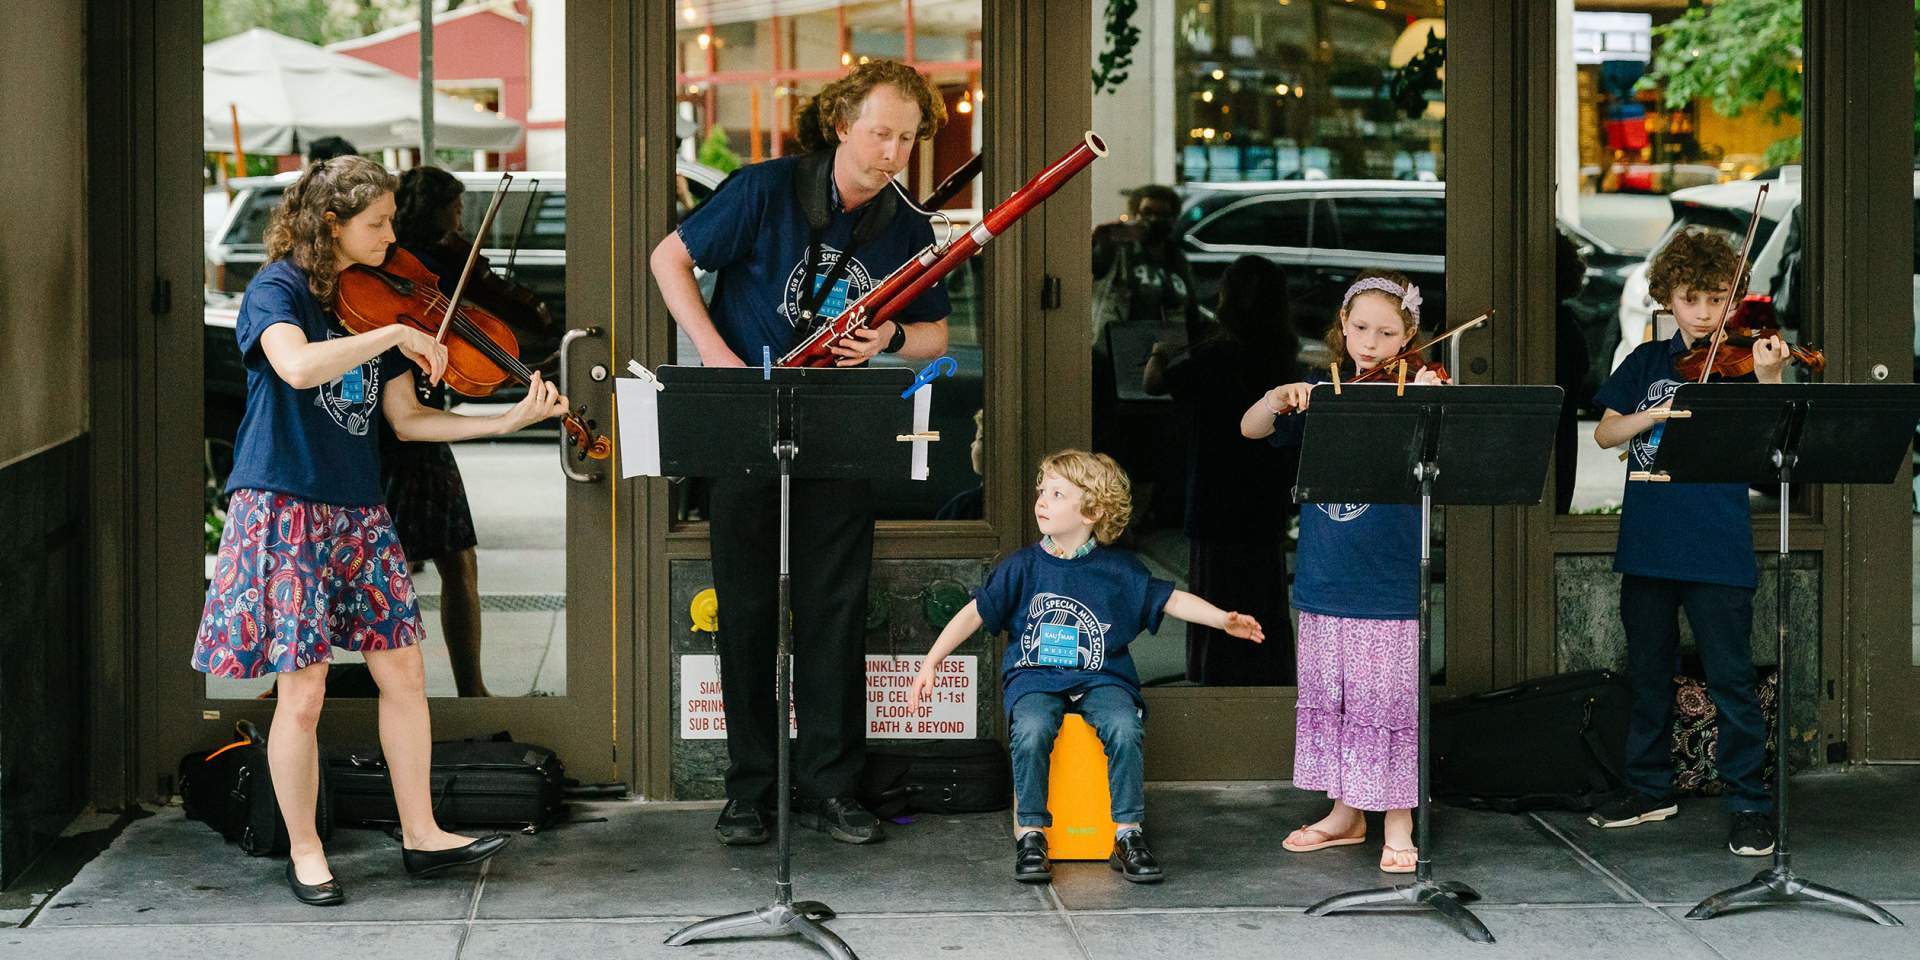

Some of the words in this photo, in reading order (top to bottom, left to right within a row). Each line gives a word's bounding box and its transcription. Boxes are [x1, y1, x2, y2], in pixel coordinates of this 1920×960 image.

[851, 264, 869, 290] MUSIC
[791, 278, 799, 292] 859
[789, 302, 798, 315] EST
[1045, 600, 1078, 612] SPECIAL
[1078, 610, 1098, 636] MUSIC
[888, 691, 932, 703] CELAR
[937, 692, 965, 703] 1-1st
[918, 706, 933, 718] OF
[689, 718, 709, 730] SUB
[871, 721, 900, 733] BATH
[904, 721, 913, 733] &
[918, 721, 965, 733] BEYOND
